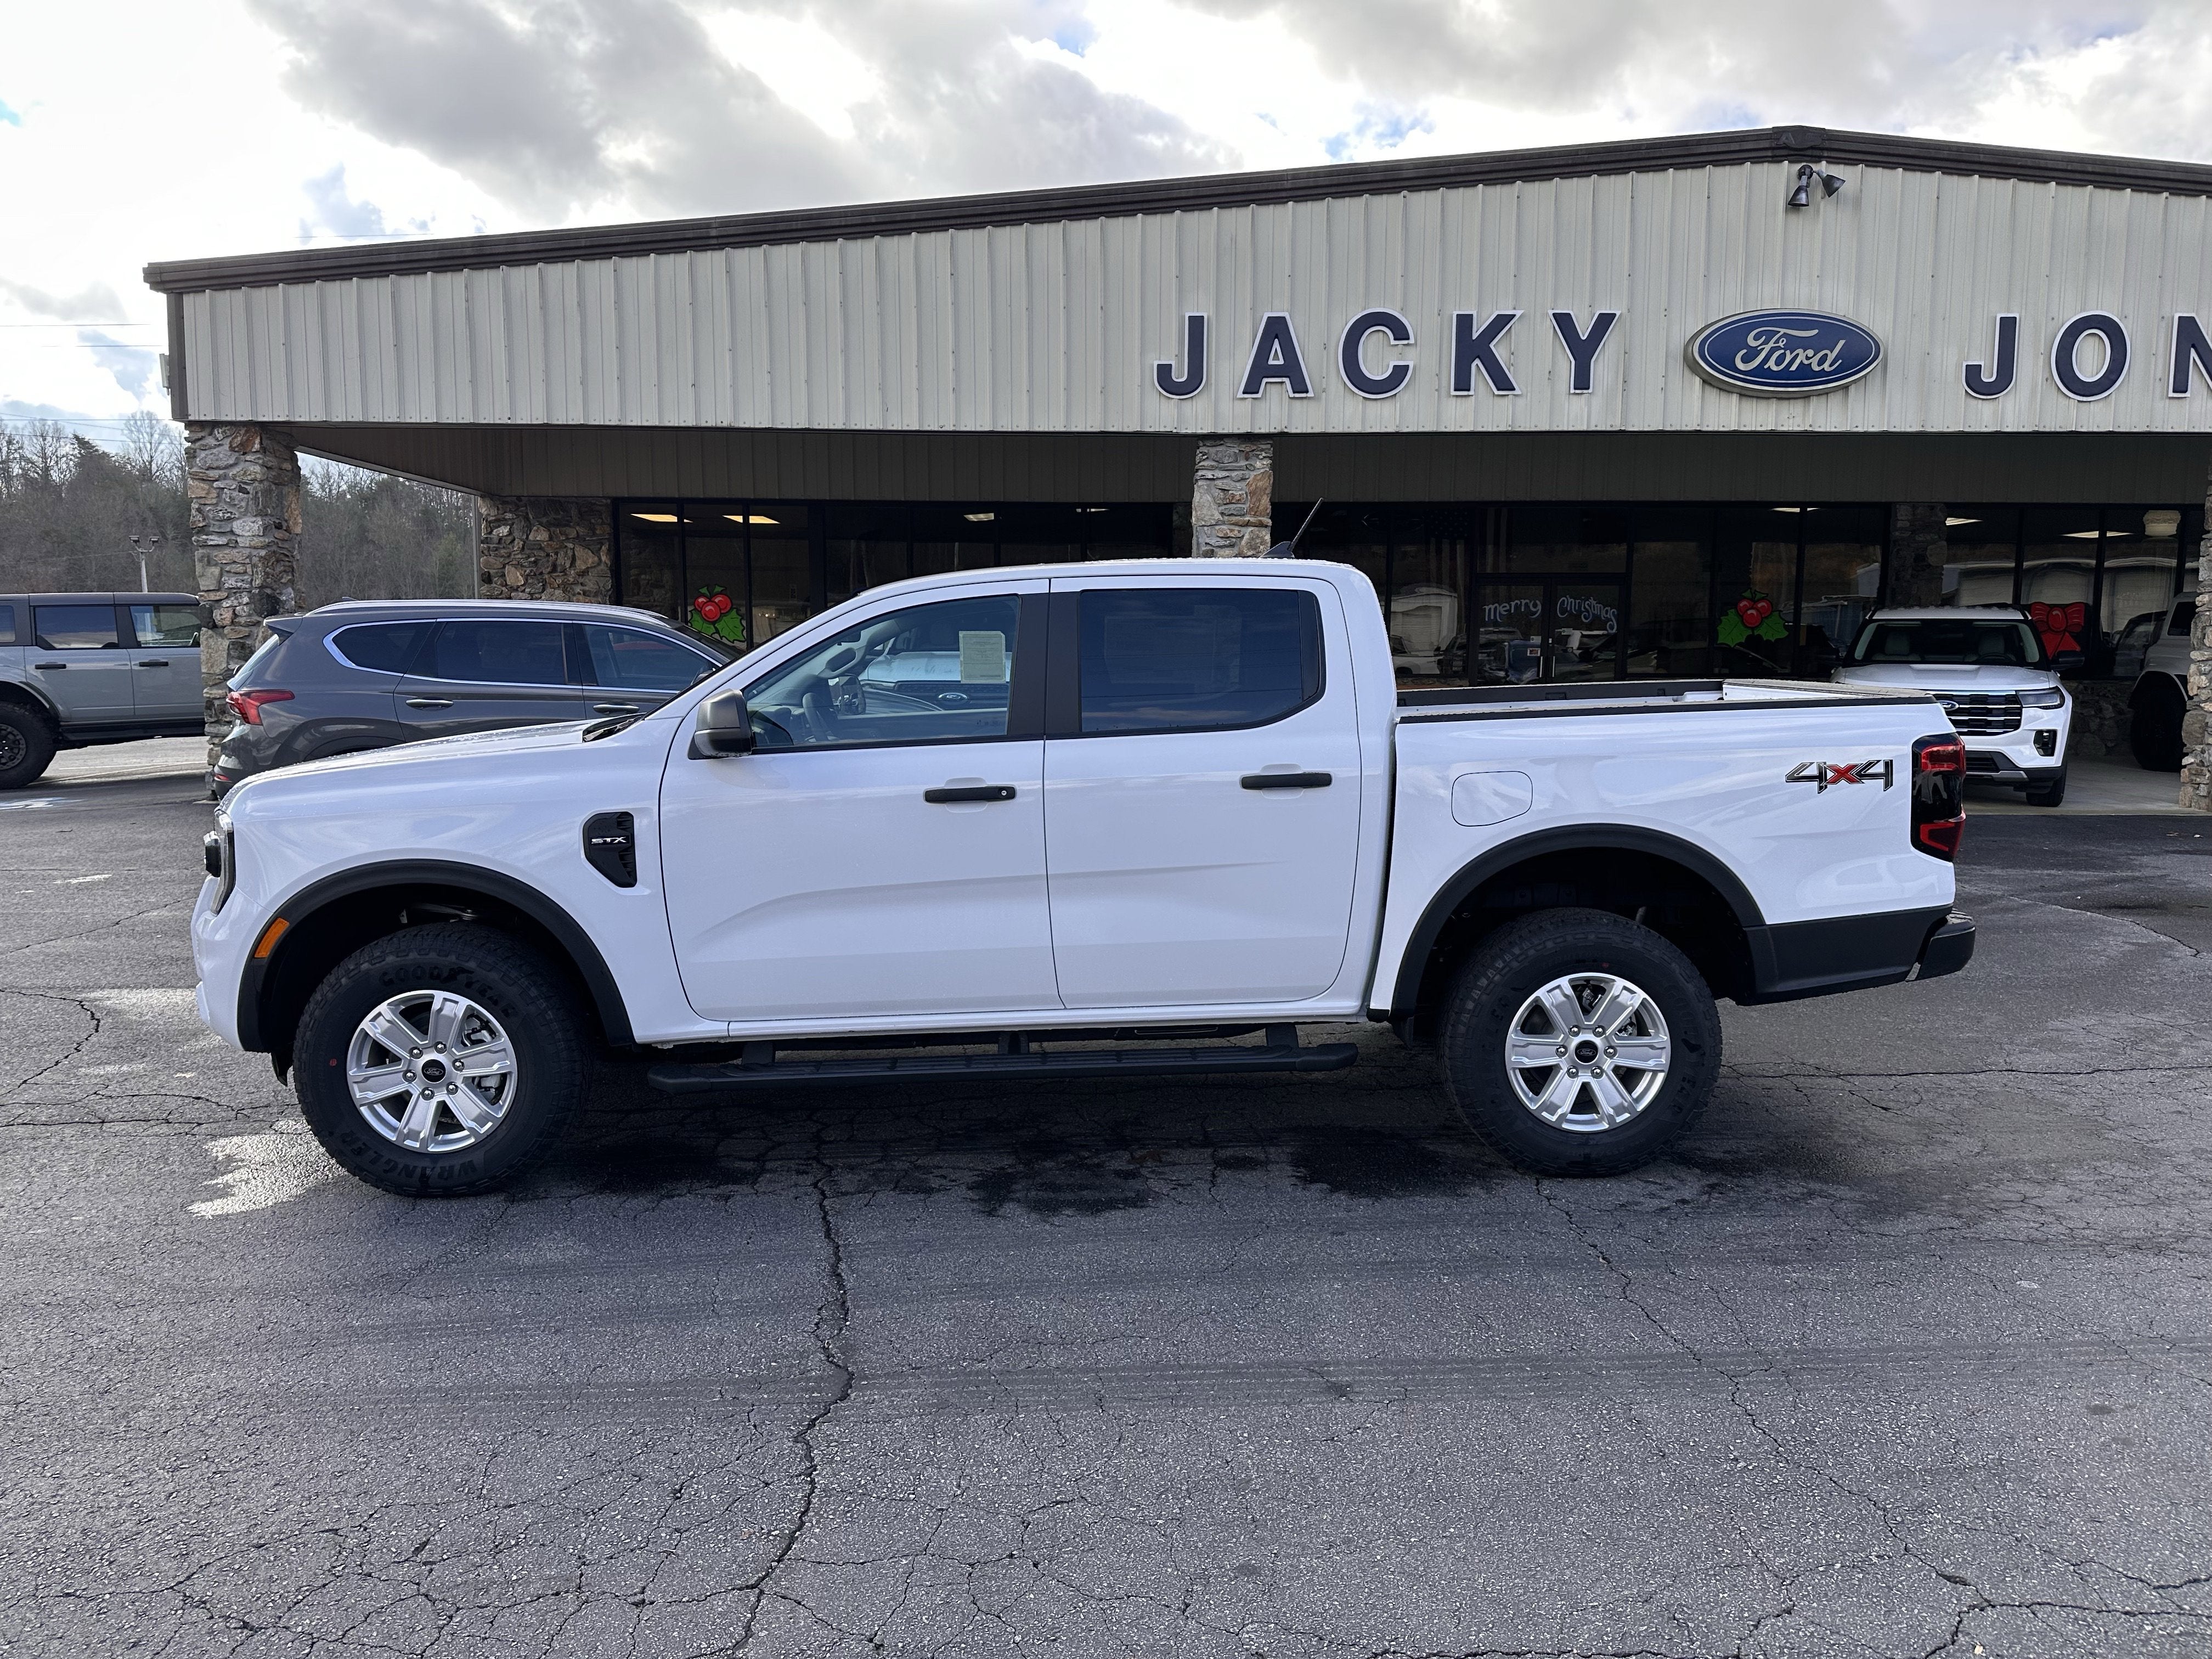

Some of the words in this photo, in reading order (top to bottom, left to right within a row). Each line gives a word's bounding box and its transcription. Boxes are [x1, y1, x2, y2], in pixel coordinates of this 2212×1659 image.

[1154, 307, 1621, 399] JACKY
[1735, 327, 1846, 371] Ford
[1557, 595, 1617, 634] Christmas
[338, 1131, 479, 1187] WRANGLER
